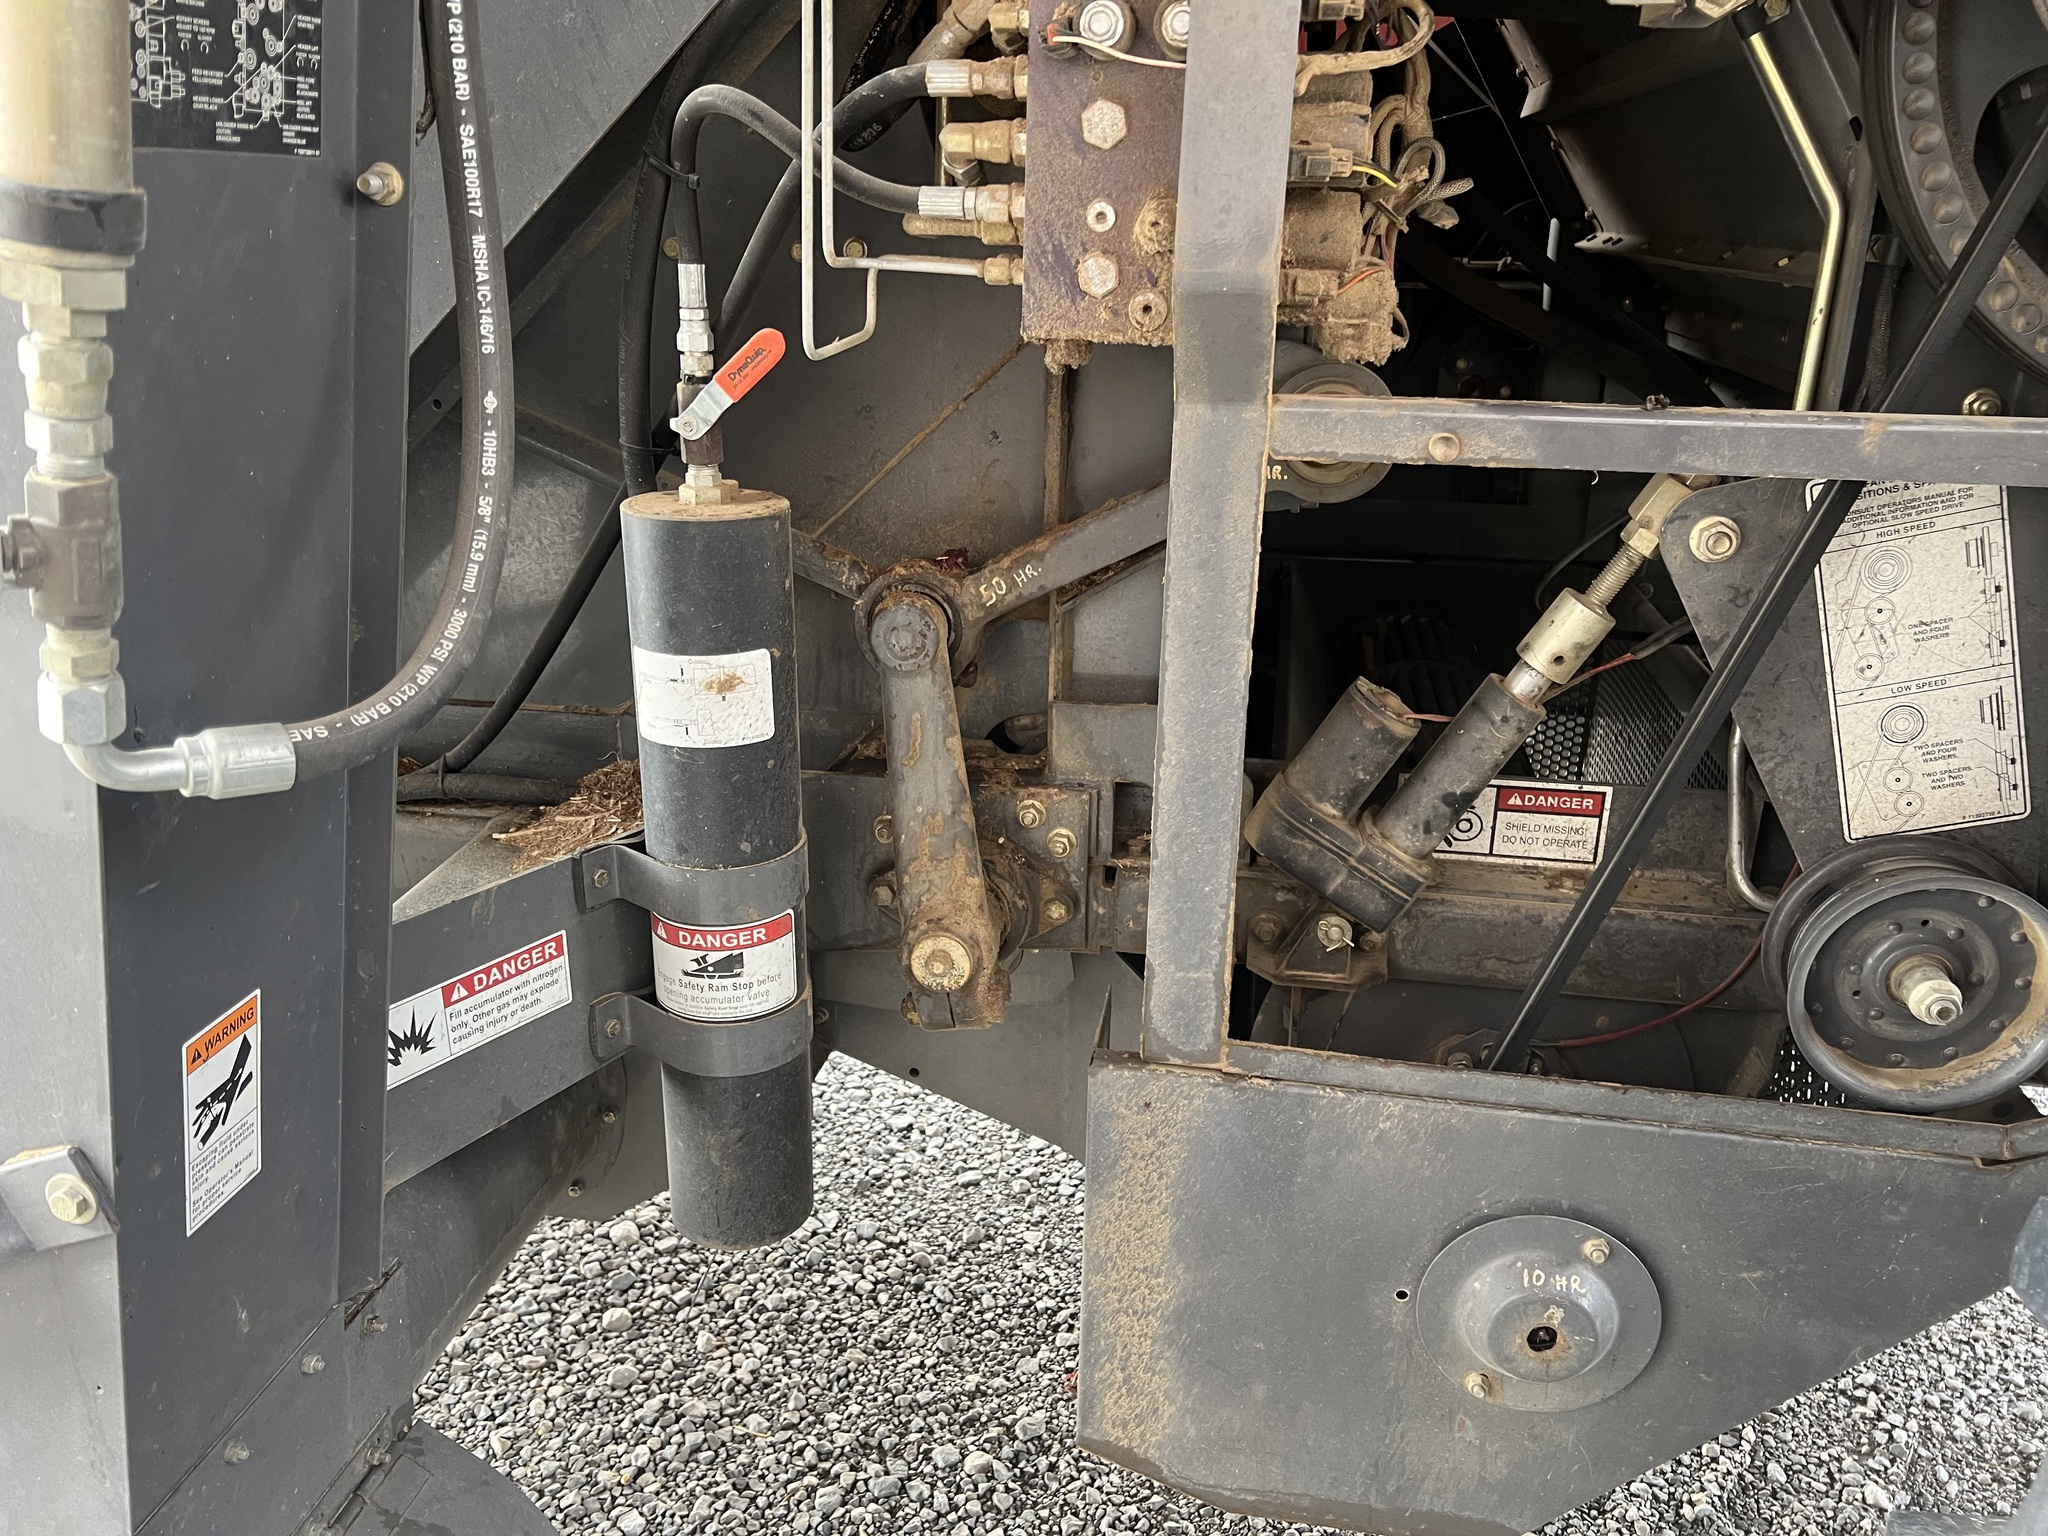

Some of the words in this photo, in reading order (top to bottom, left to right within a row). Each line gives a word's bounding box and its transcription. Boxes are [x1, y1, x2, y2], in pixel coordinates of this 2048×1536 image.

[448, 18, 466, 54] (210
[452, 58, 470, 102] BAR)
[459, 124, 484, 218] SAE100R17
[471, 235, 490, 282] MSHA
[476, 286, 496, 354] IC-146/16
[480, 430, 498, 478] 10HB3
[476, 495, 494, 524] 5/8"
[1876, 497, 1922, 510] OPERATORS
[1924, 490, 1956, 500] MANUAL
[1888, 500, 1939, 515] INFORMATION
[1940, 496, 1956, 505] AND
[1958, 492, 1974, 500] FOR
[1852, 516, 1890, 529] OPTIONAL
[1891, 512, 1914, 521] SLOW
[1915, 506, 1940, 517] SPEED
[1941, 502, 1965, 511] DRIVE
[1876, 528, 1900, 539] HIGH
[1904, 521, 1937, 534] SPEED
[468, 530, 488, 562] (15.9
[460, 563, 480, 593] mm)
[978, 576, 1007, 607] 50
[1012, 564, 1042, 588] HR.
[444, 608, 468, 640] 3000
[1912, 628, 1928, 636] AND
[1930, 624, 1950, 634] FOUR
[430, 638, 454, 663] PSI
[1914, 632, 1950, 644] WASHERS
[416, 664, 440, 688] WP
[1890, 684, 1913, 696] LOW
[1915, 678, 1948, 690] SPEED
[388, 682, 420, 708] (210
[348, 702, 392, 728] BAR)
[1914, 743, 1930, 752] TWO
[1930, 738, 1964, 750] SPACERS
[1921, 748, 1937, 757] AND
[1938, 746, 1958, 755] FOUR
[1922, 753, 1958, 764] WASHERS
[1922, 771, 1938, 780] TWO
[1939, 766, 1972, 777] SPACERS
[1930, 780, 1966, 792] WASHERS
[1931, 775, 1947, 784] AND
[1524, 794, 1594, 810] DANGER
[1505, 822, 1540, 832] SHIELD
[1502, 834, 1516, 844] DO
[1520, 836, 1540, 846] NOT
[1542, 837, 1588, 850] OPERATE
[679, 928, 767, 948] DANGER
[473, 941, 558, 992] DANGER
[449, 1010, 462, 1022] Fill
[464, 988, 513, 1016] accumulator
[514, 979, 531, 992] with
[532, 966, 563, 986] nitrogen
[678, 978, 705, 994] Safety
[708, 983, 729, 992] Ram
[732, 981, 754, 992] Stop
[756, 972, 782, 988] before
[450, 1020, 470, 1033] only.
[472, 1008, 494, 1024] Other
[496, 1002, 511, 1013] gas
[512, 994, 528, 1006] may
[530, 978, 560, 997] explode
[690, 994, 745, 1005] accumulator
[204, 1006, 255, 1054] WARNING
[452, 1024, 484, 1044] causing
[486, 1012, 508, 1029] injury
[510, 1008, 518, 1017] or
[520, 997, 544, 1013] death.
[192, 1146, 218, 1172] Escaping
[218, 1134, 232, 1148] fluid
[233, 1120, 249, 1136] under
[192, 1154, 217, 1180] pressure
[218, 1146, 228, 1156] can
[230, 1122, 255, 1148] penetrate
[192, 1172, 204, 1186] skin
[206, 1162, 216, 1174] and
[218, 1148, 234, 1164] cause
[234, 1130, 255, 1150] serious
[192, 1195, 203, 1208] See
[204, 1167, 234, 1196] Operator's
[234, 1149, 254, 1168] Manual
[192, 1204, 201, 1215] for
[202, 1184, 221, 1208] proper
[222, 1168, 242, 1188] service
[1523, 1268, 1546, 1288] 10
[1555, 1274, 1588, 1294] HR
